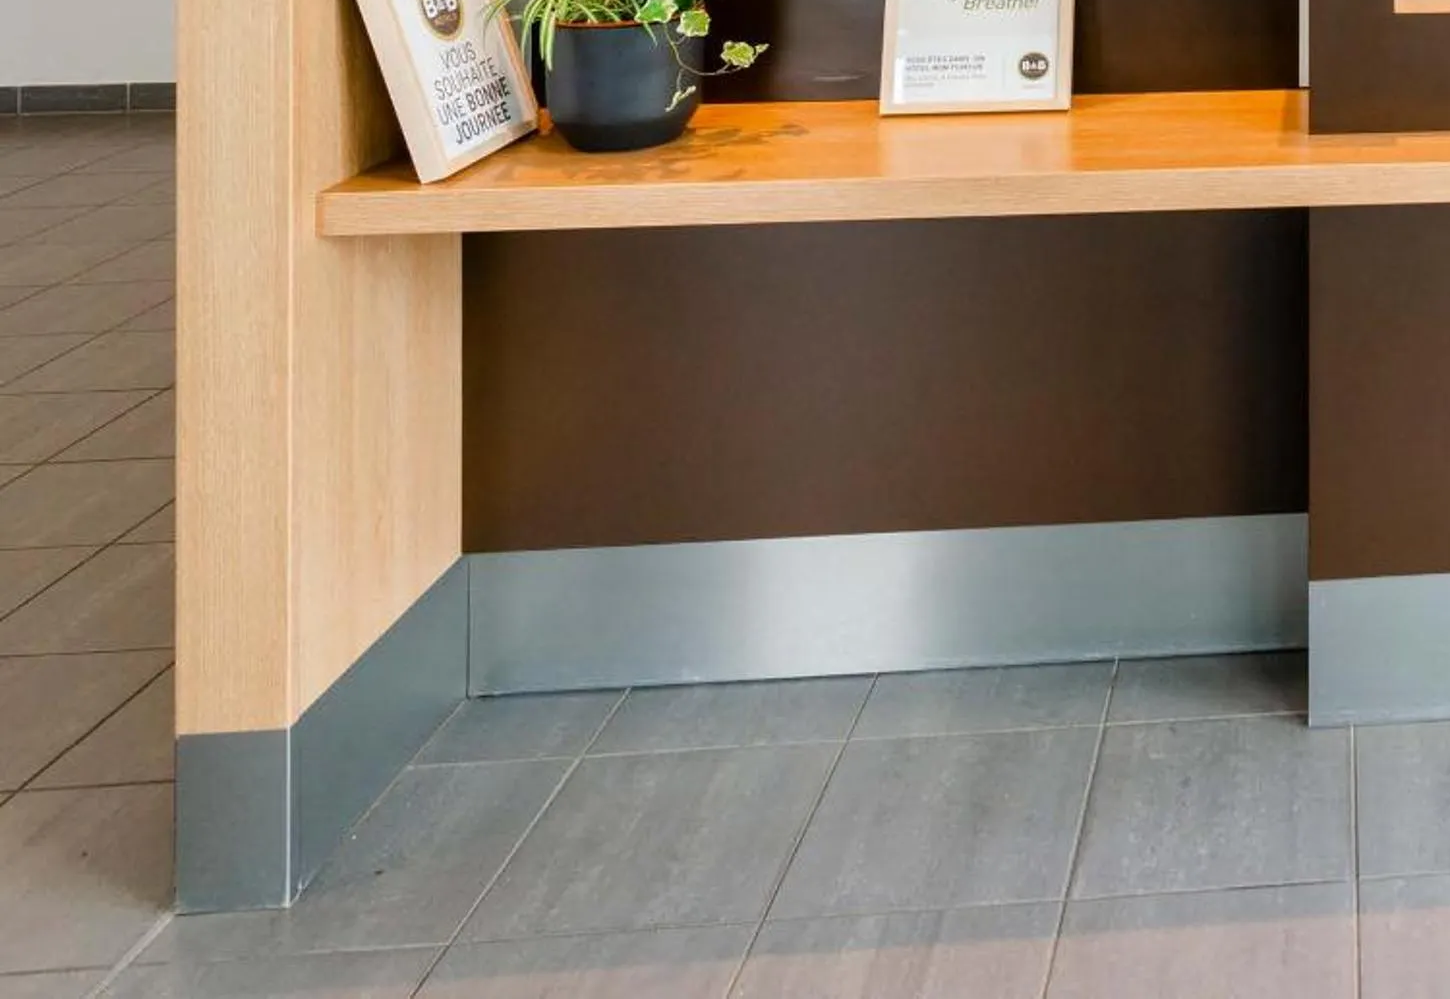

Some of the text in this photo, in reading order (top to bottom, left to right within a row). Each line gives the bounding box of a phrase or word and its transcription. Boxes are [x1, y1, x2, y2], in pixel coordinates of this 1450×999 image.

[440, 41, 477, 70] VOUS
[434, 56, 498, 101] SOUHAITE
[436, 76, 511, 126] UNE BONNE
